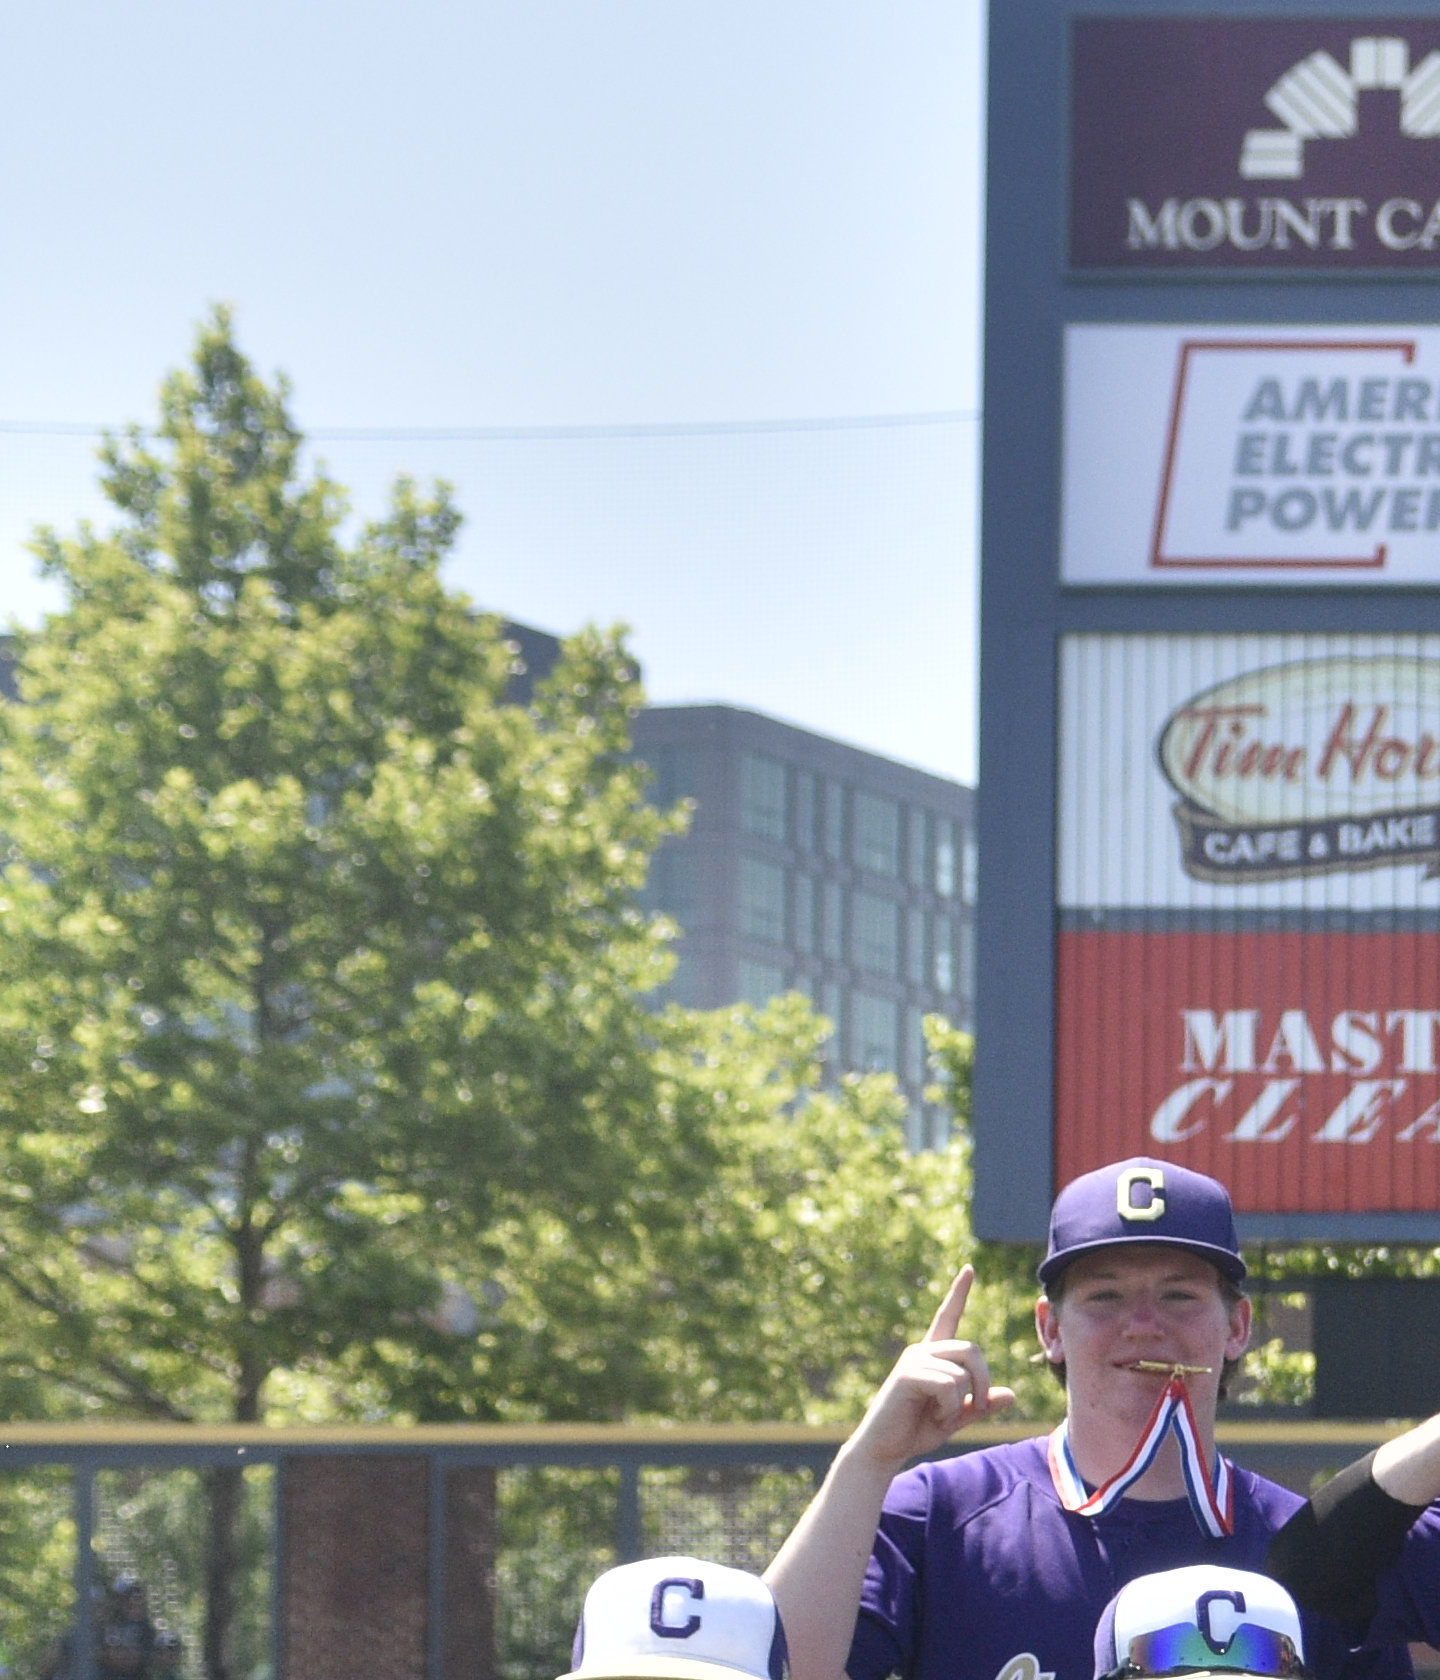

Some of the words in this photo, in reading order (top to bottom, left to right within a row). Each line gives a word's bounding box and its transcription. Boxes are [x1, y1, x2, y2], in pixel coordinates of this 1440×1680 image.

[1127, 199, 1366, 250] MOUNT
[1180, 704, 1303, 783] Tim
[1204, 822, 1300, 864] CAFE
[1338, 815, 1435, 855] BAKE
[1116, 1167, 1166, 1221] C
[649, 1577, 705, 1638] C
